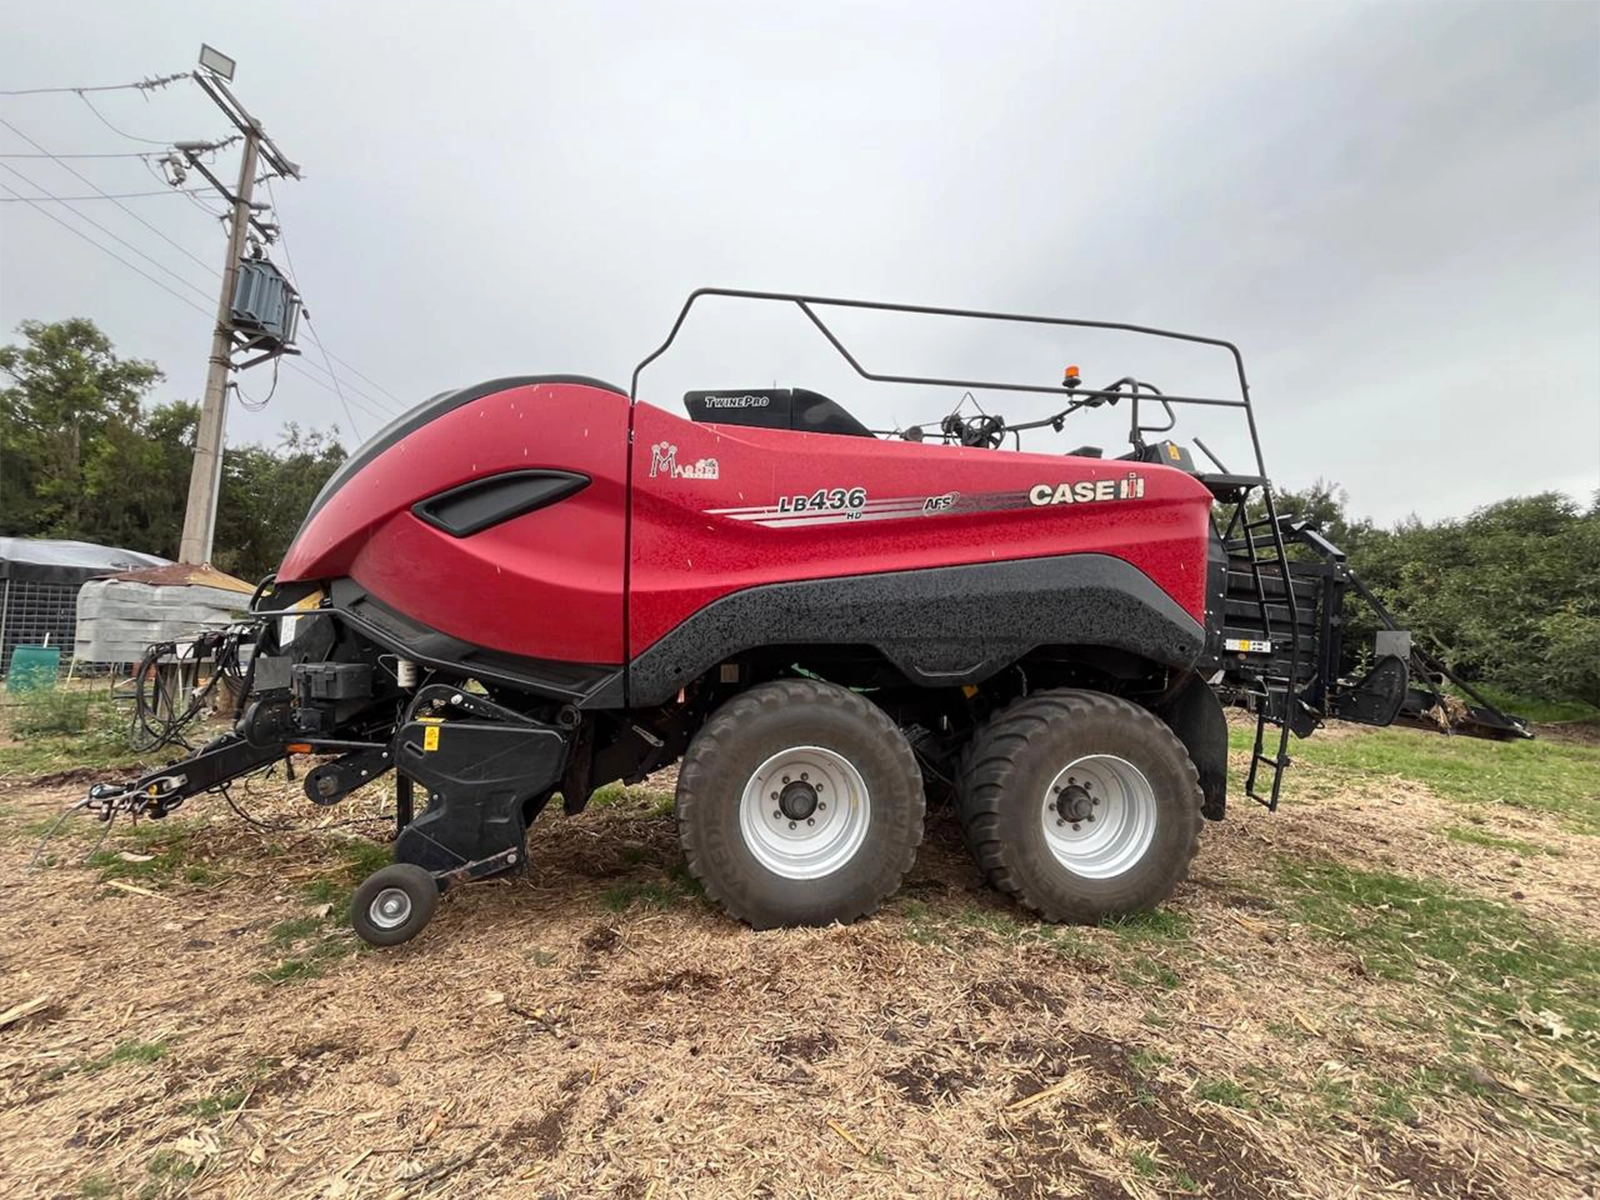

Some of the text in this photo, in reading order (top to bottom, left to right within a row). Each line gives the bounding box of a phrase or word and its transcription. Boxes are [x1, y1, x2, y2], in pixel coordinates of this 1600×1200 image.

[778, 487, 866, 514] LB436
[1029, 480, 1115, 506] CASE
[924, 497, 951, 511] AFS
[846, 511, 862, 520] HD
